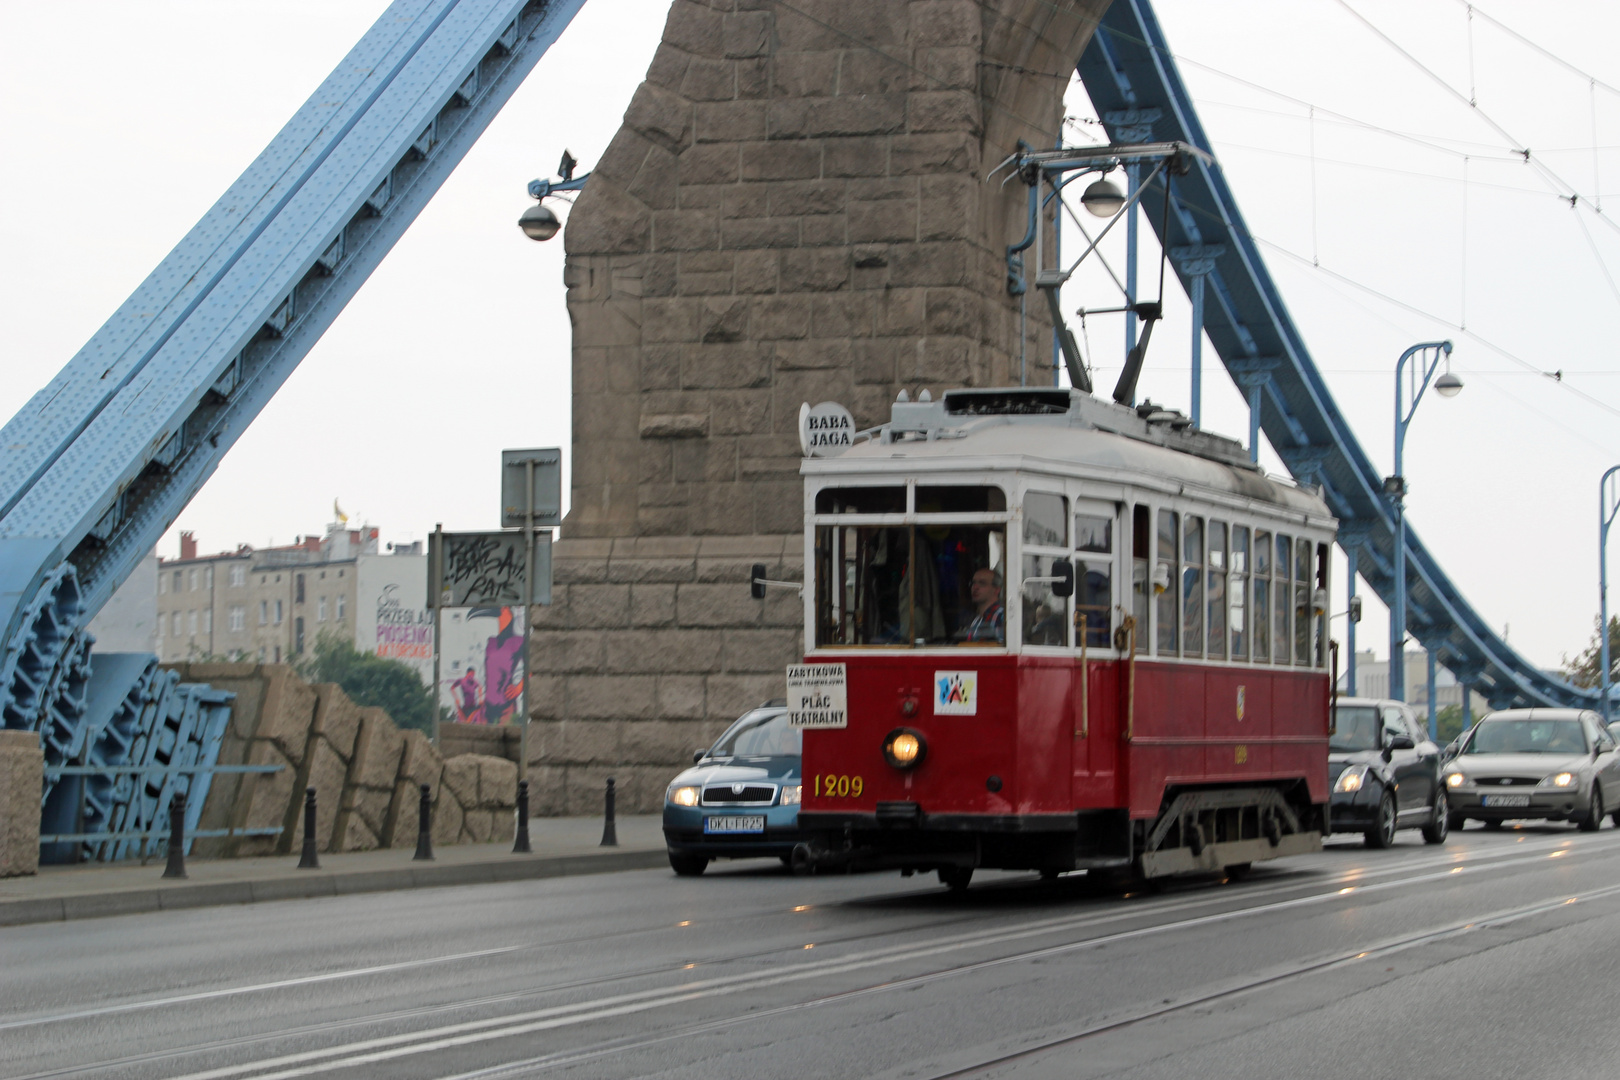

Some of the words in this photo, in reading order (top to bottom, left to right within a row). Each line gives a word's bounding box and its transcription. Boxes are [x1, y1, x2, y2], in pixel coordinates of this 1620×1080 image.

[809, 415, 850, 430] BABA
[810, 431, 850, 446] JAGA
[788, 666, 844, 678] ZABYTKOWA
[801, 696, 831, 709] PLAC
[790, 711, 844, 725] TEATRALNY
[815, 774, 864, 798] 1209
